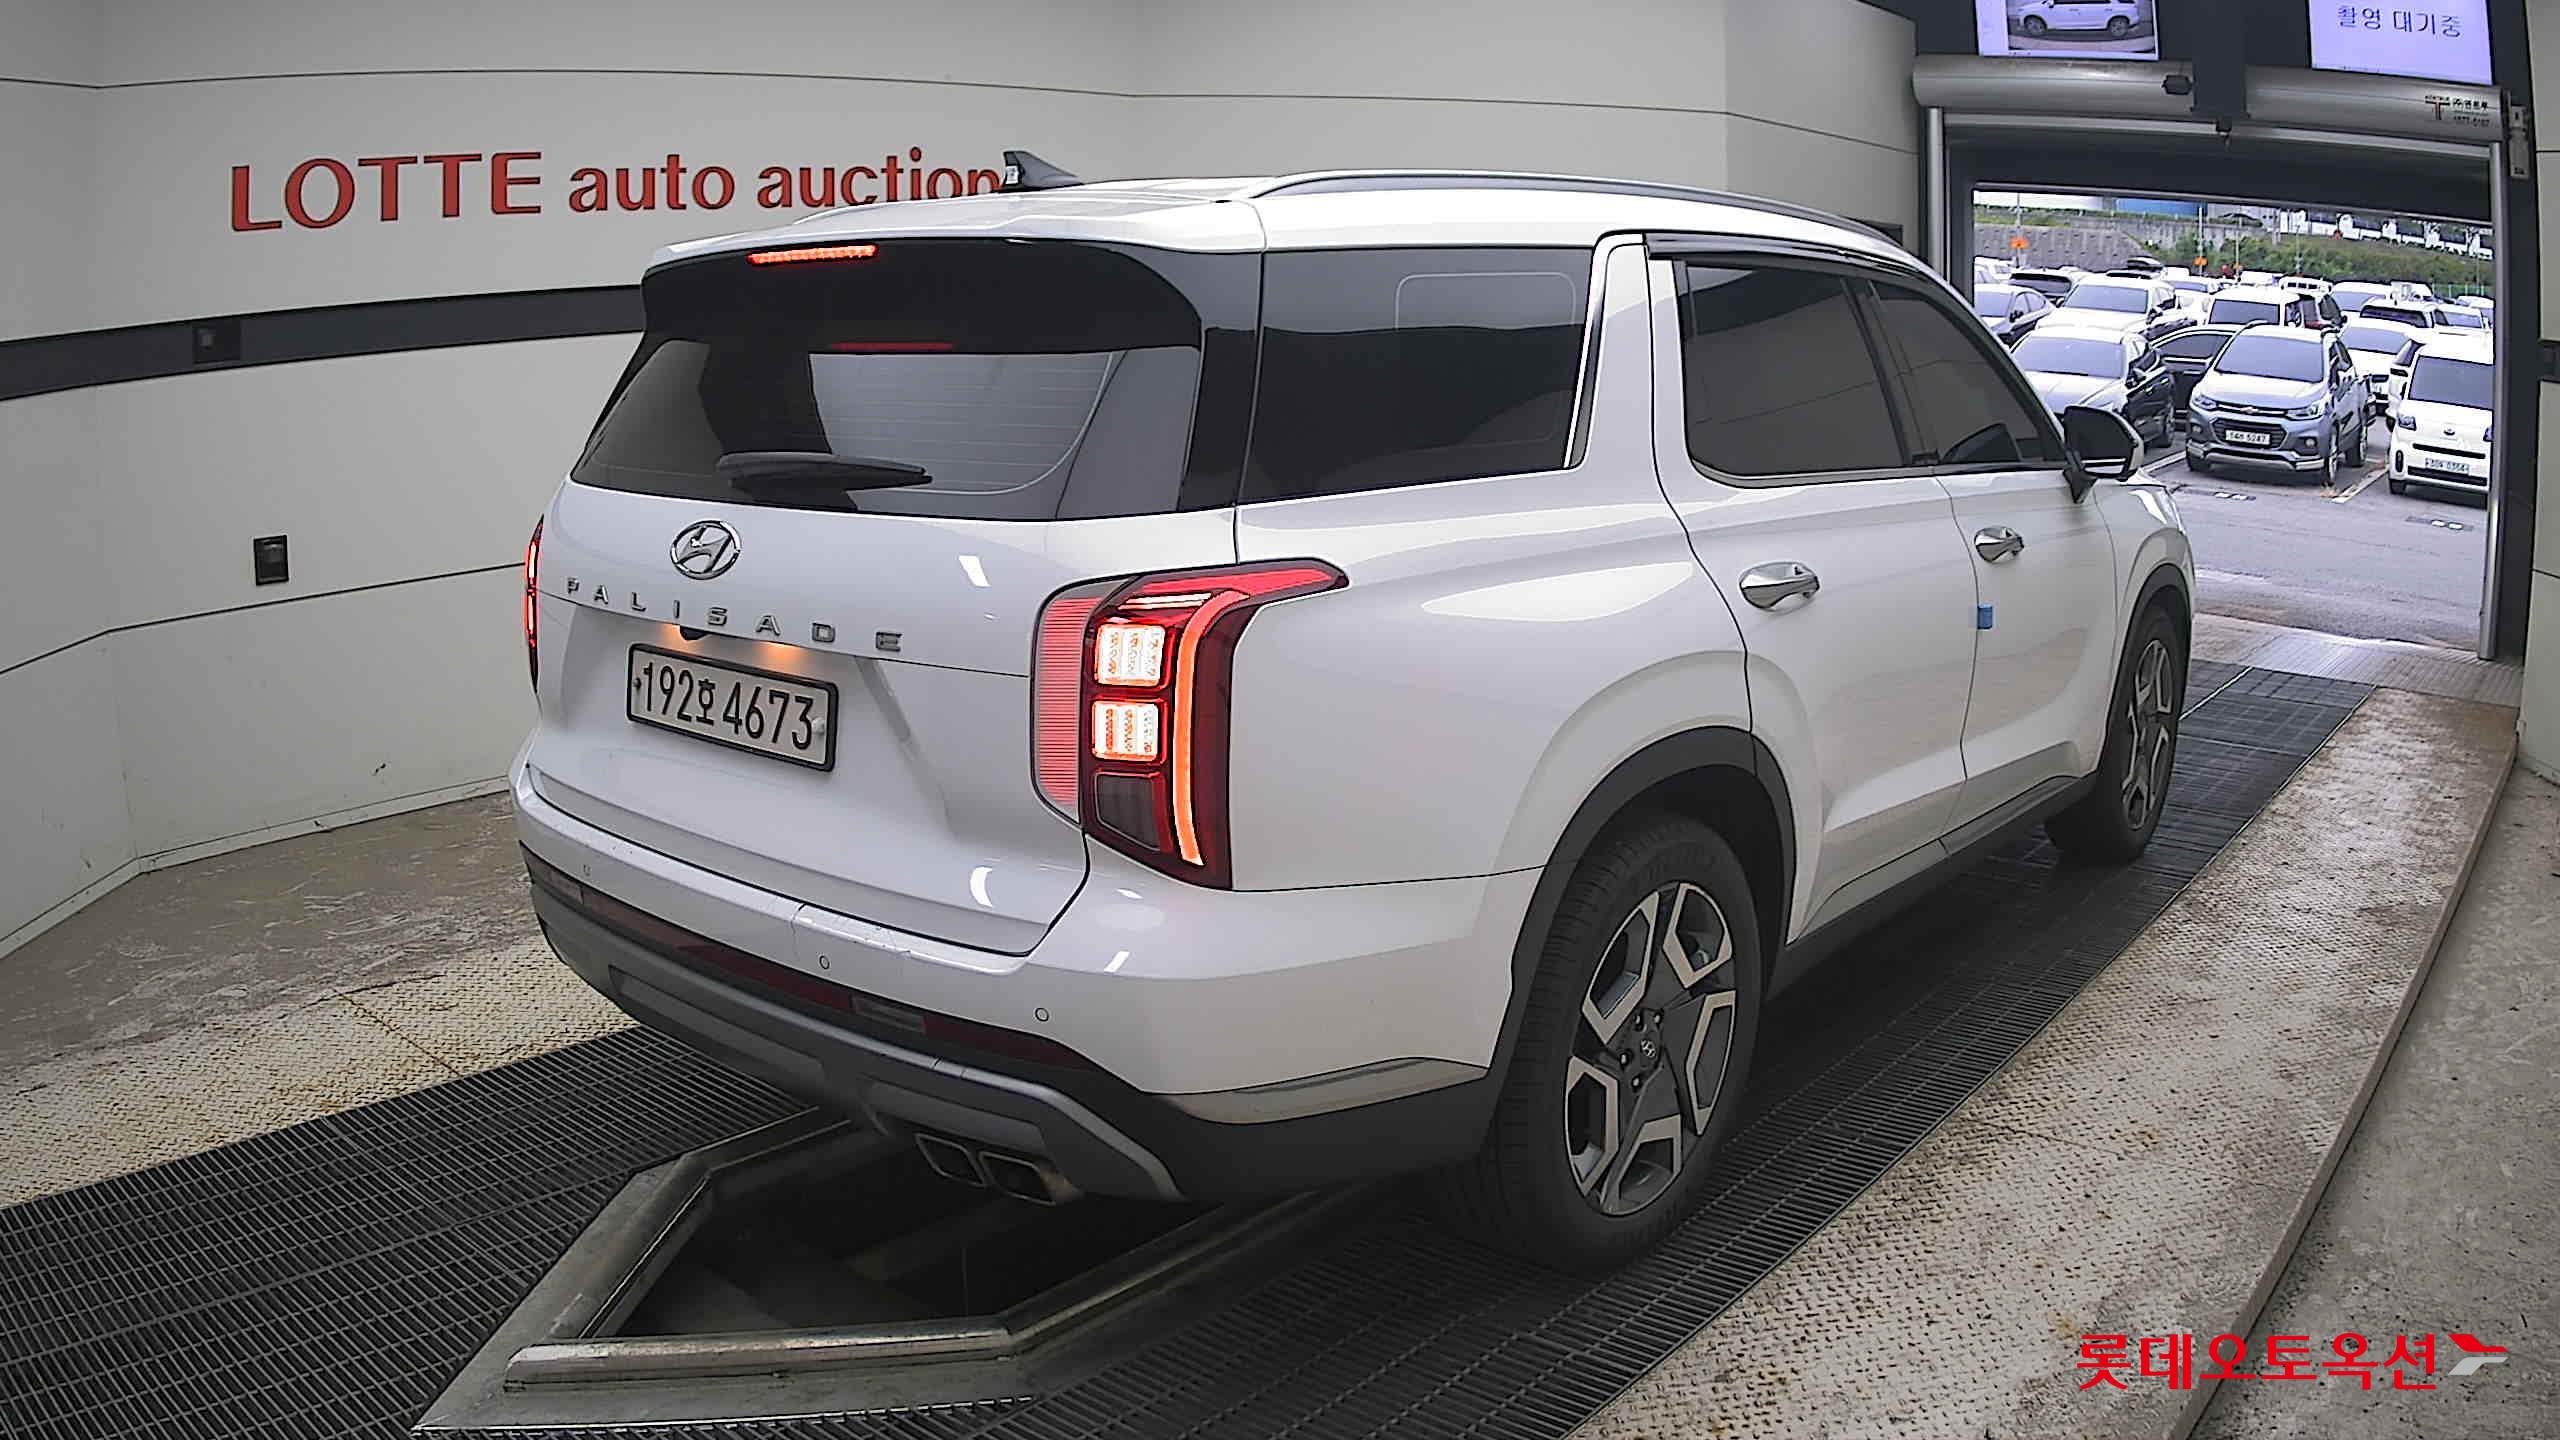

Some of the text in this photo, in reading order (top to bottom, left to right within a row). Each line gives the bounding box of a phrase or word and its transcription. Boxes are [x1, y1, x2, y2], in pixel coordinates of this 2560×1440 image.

[2338, 6, 2461, 38] 촬영 대기중
[231, 146, 1000, 232] LOTTE auto auction
[566, 576, 902, 652] PALISADE
[722, 681, 814, 750] 4673
